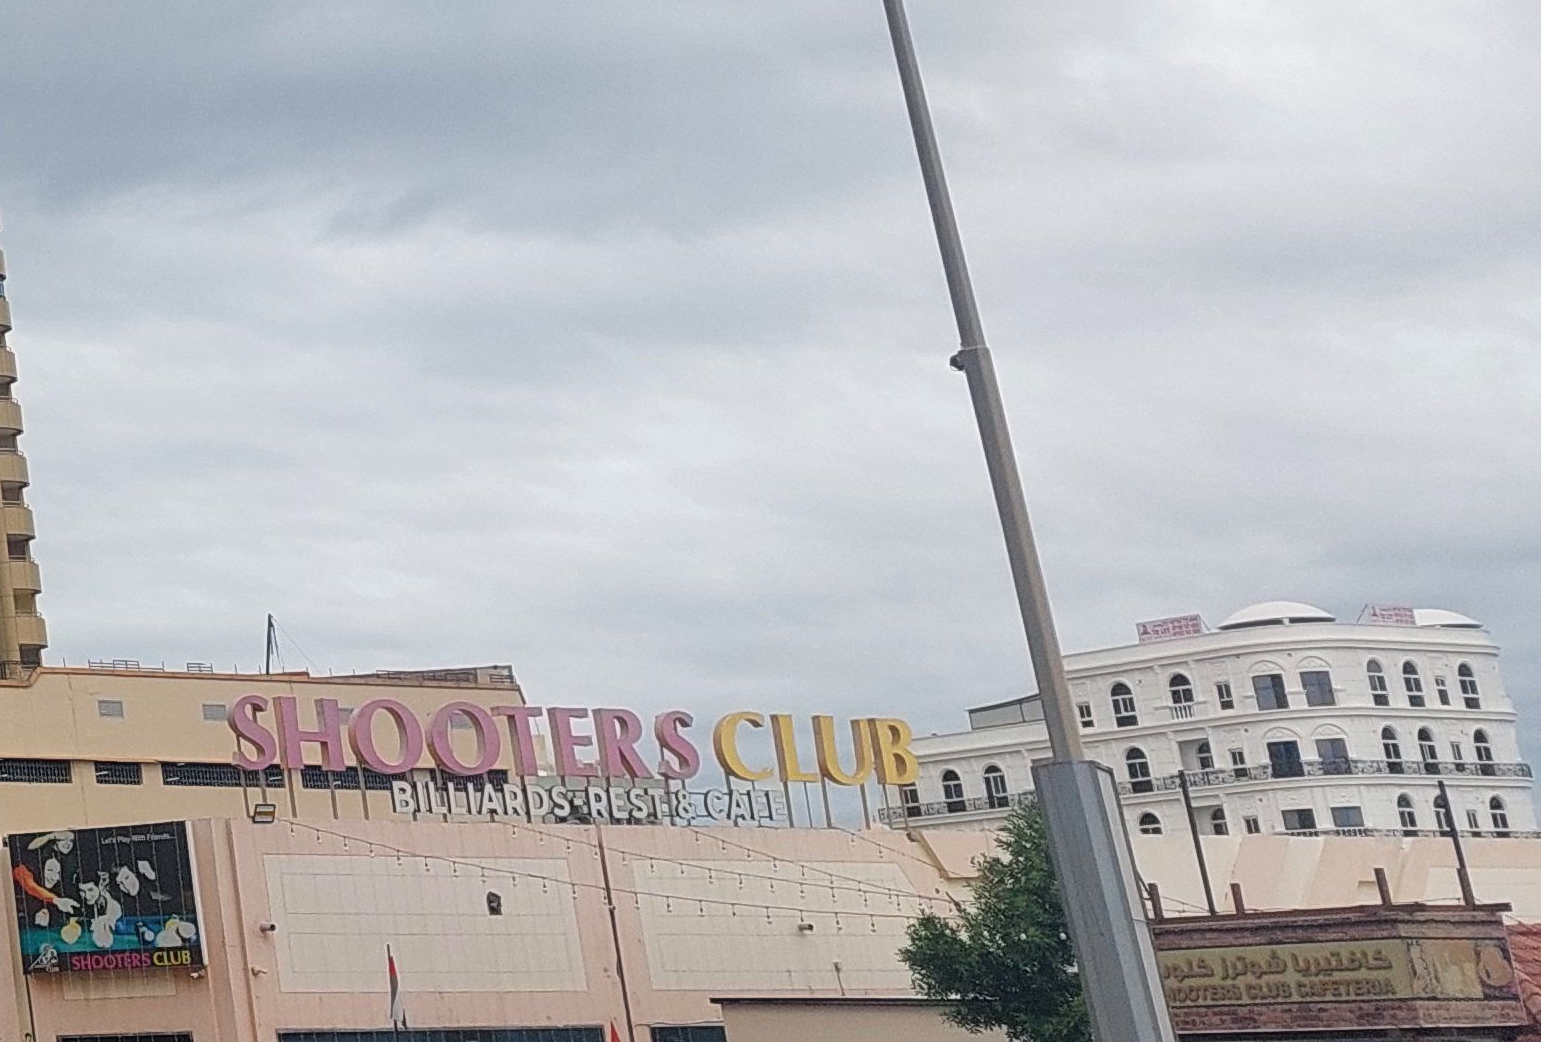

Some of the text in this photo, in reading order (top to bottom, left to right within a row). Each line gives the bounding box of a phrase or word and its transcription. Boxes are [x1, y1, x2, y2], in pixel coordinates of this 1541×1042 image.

[227, 694, 918, 787] SHOOTERS CLUB
[675, 788, 697, 819] &
[704, 789, 789, 822] CAFE
[71, 950, 192, 971] SHOOTERS CLUB
[1245, 979, 1293, 1001] CLUB
[1296, 976, 1397, 999] CAFETERIA
